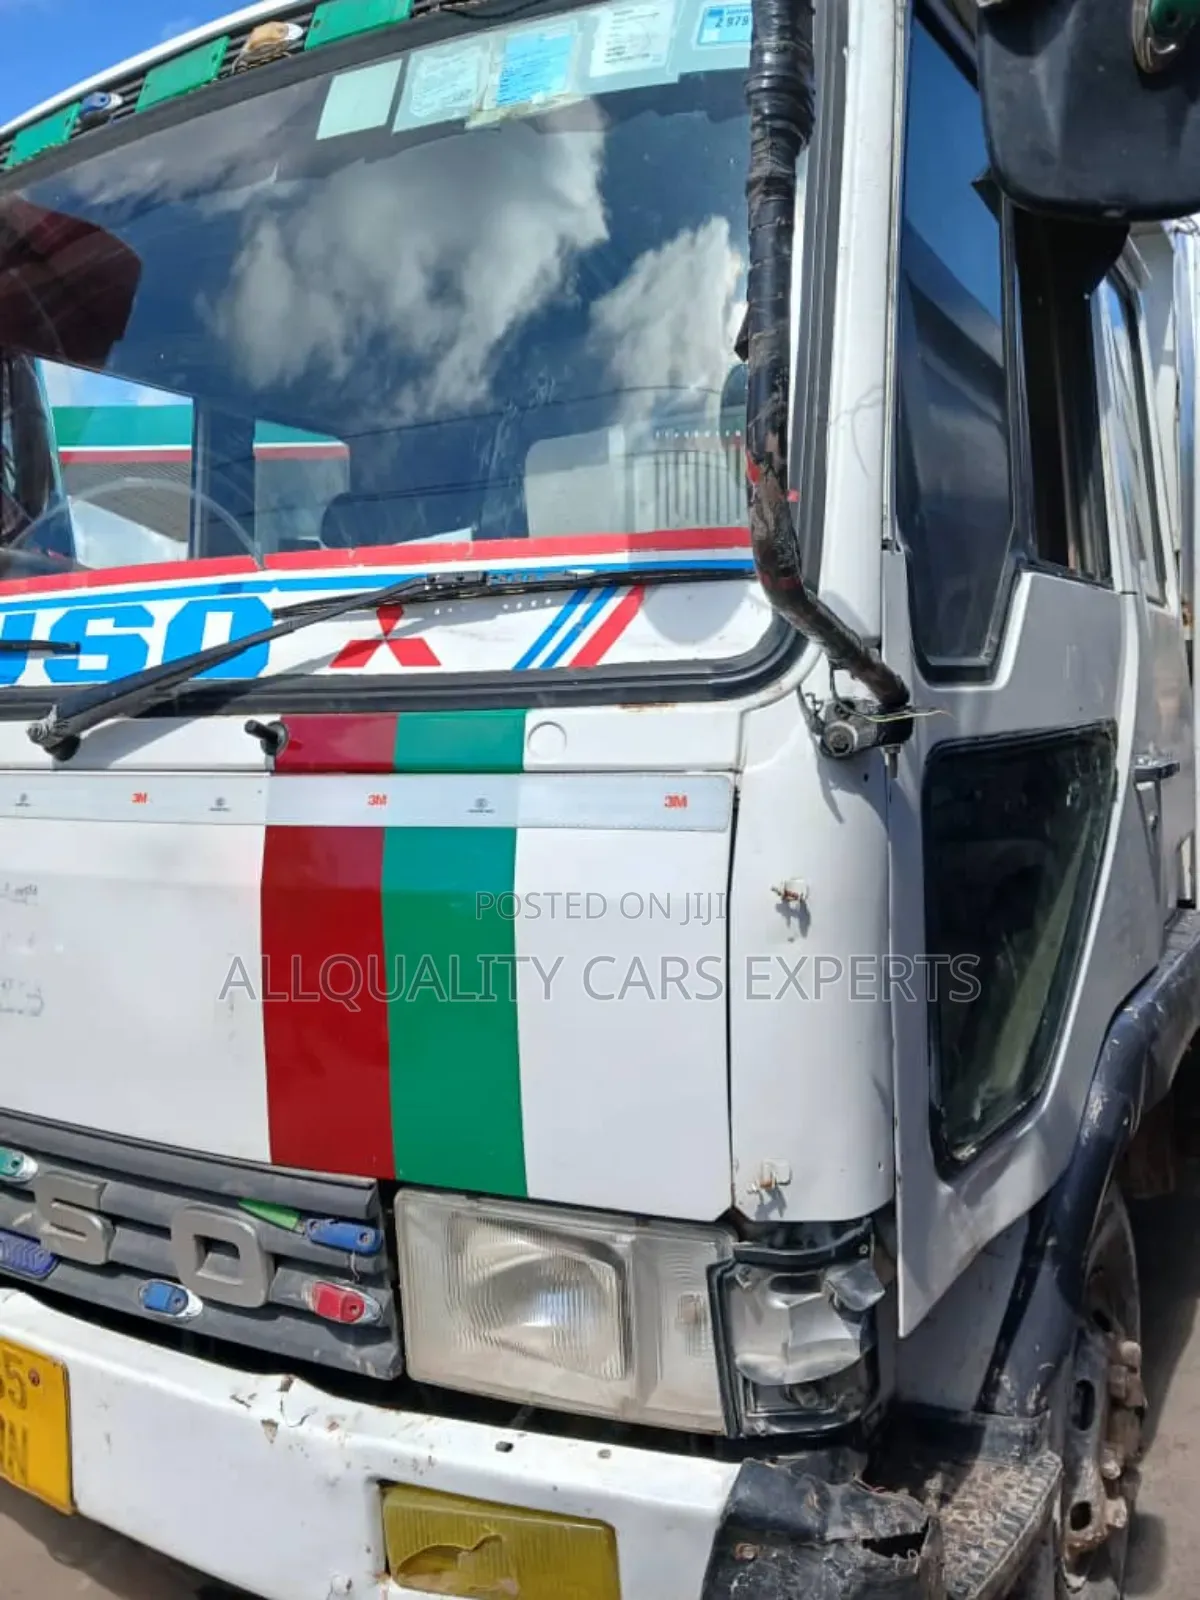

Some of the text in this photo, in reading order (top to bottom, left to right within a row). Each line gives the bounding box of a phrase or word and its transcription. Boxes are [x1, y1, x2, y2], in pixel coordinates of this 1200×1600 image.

[131, 792, 149, 804] 3M
[367, 793, 388, 806] 3M
[664, 794, 688, 808] 3M
